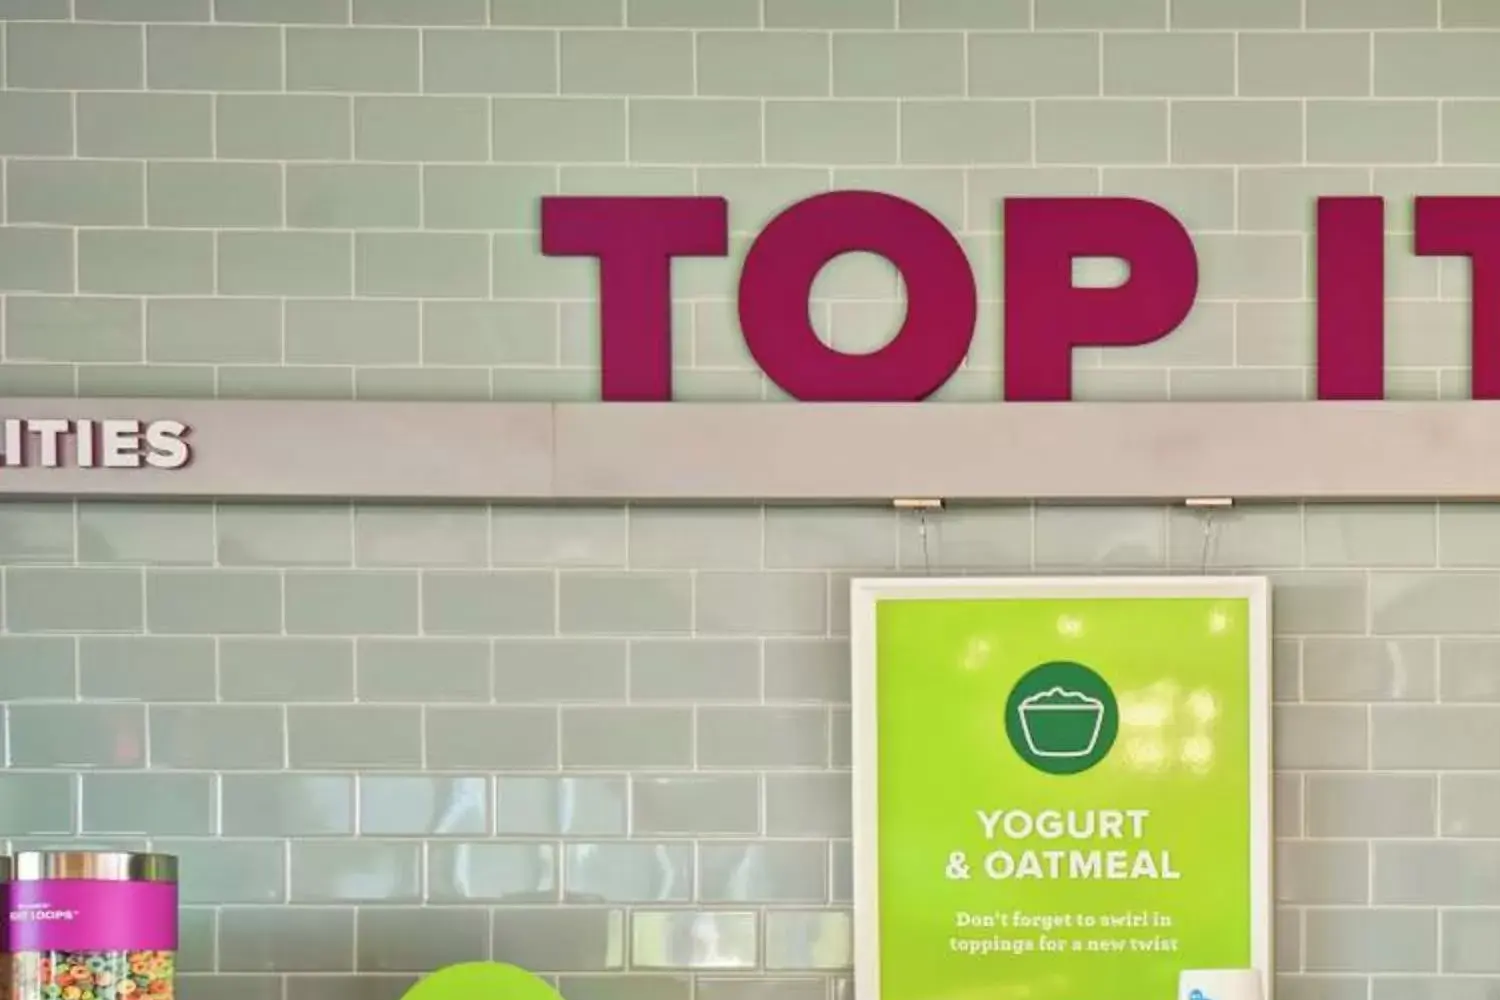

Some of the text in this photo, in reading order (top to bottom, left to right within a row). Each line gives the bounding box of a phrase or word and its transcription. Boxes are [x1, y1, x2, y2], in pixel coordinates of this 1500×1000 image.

[541, 190, 1199, 401] TOP
[0, 418, 193, 469] ITIES
[976, 808, 1150, 840] YOGURT
[946, 849, 1181, 880] & OATMEAL
[955, 910, 1172, 931] Don't forget to swirl in
[949, 935, 1179, 955] toppings for a new twist
